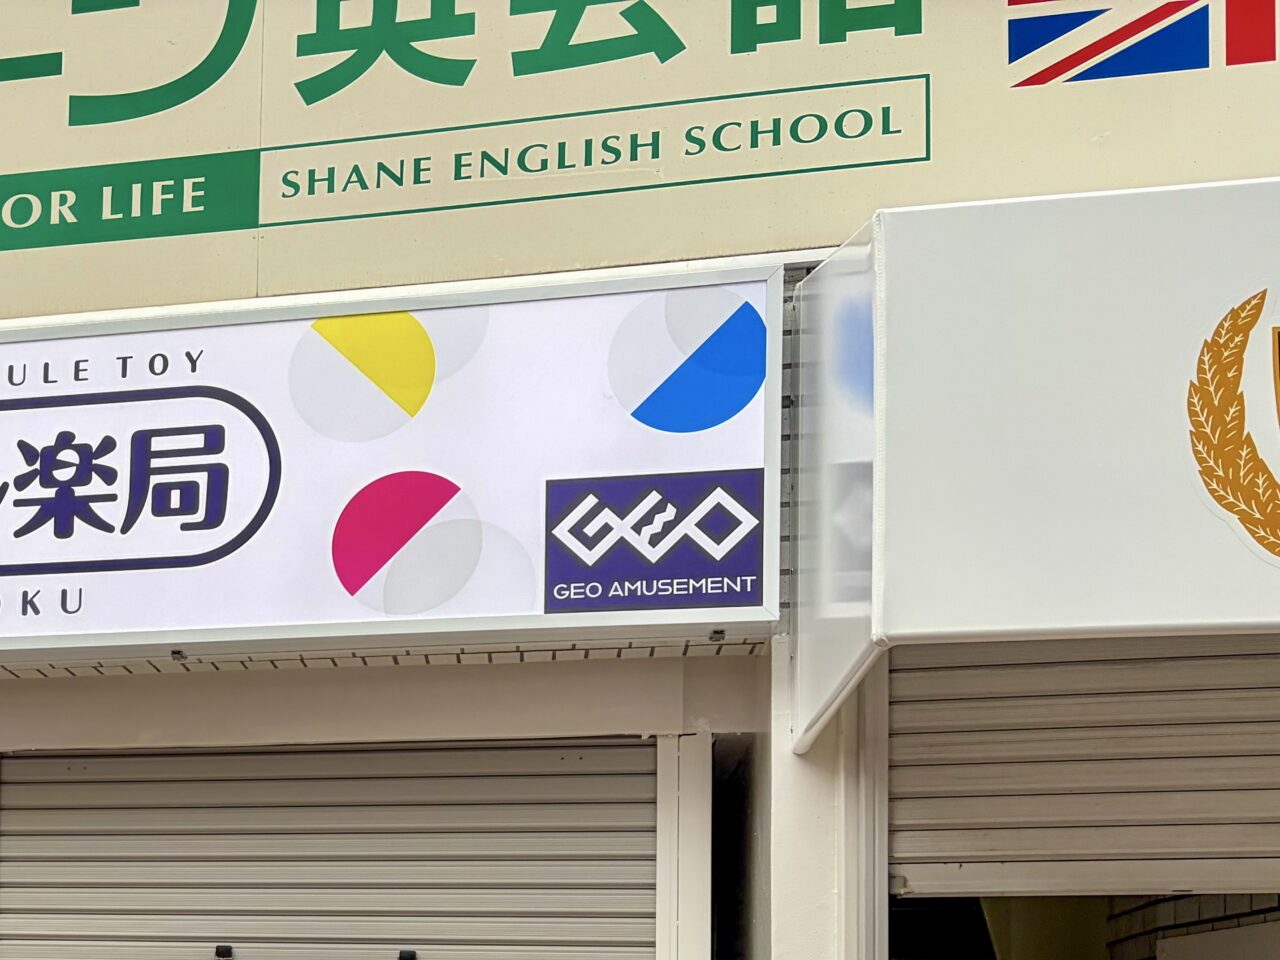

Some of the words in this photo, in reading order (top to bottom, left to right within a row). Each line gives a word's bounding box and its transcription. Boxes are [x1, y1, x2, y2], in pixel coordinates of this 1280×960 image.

[281, 157, 433, 198] SHANE
[453, 131, 661, 181] ENGLISH
[684, 106, 902, 157] SCHOOL
[101, 177, 206, 221] LIFE
[115, 350, 205, 378] TOY
[551, 486, 760, 567] GEO
[553, 582, 603, 600] GEO
[608, 576, 757, 598] AMUSEMENT
